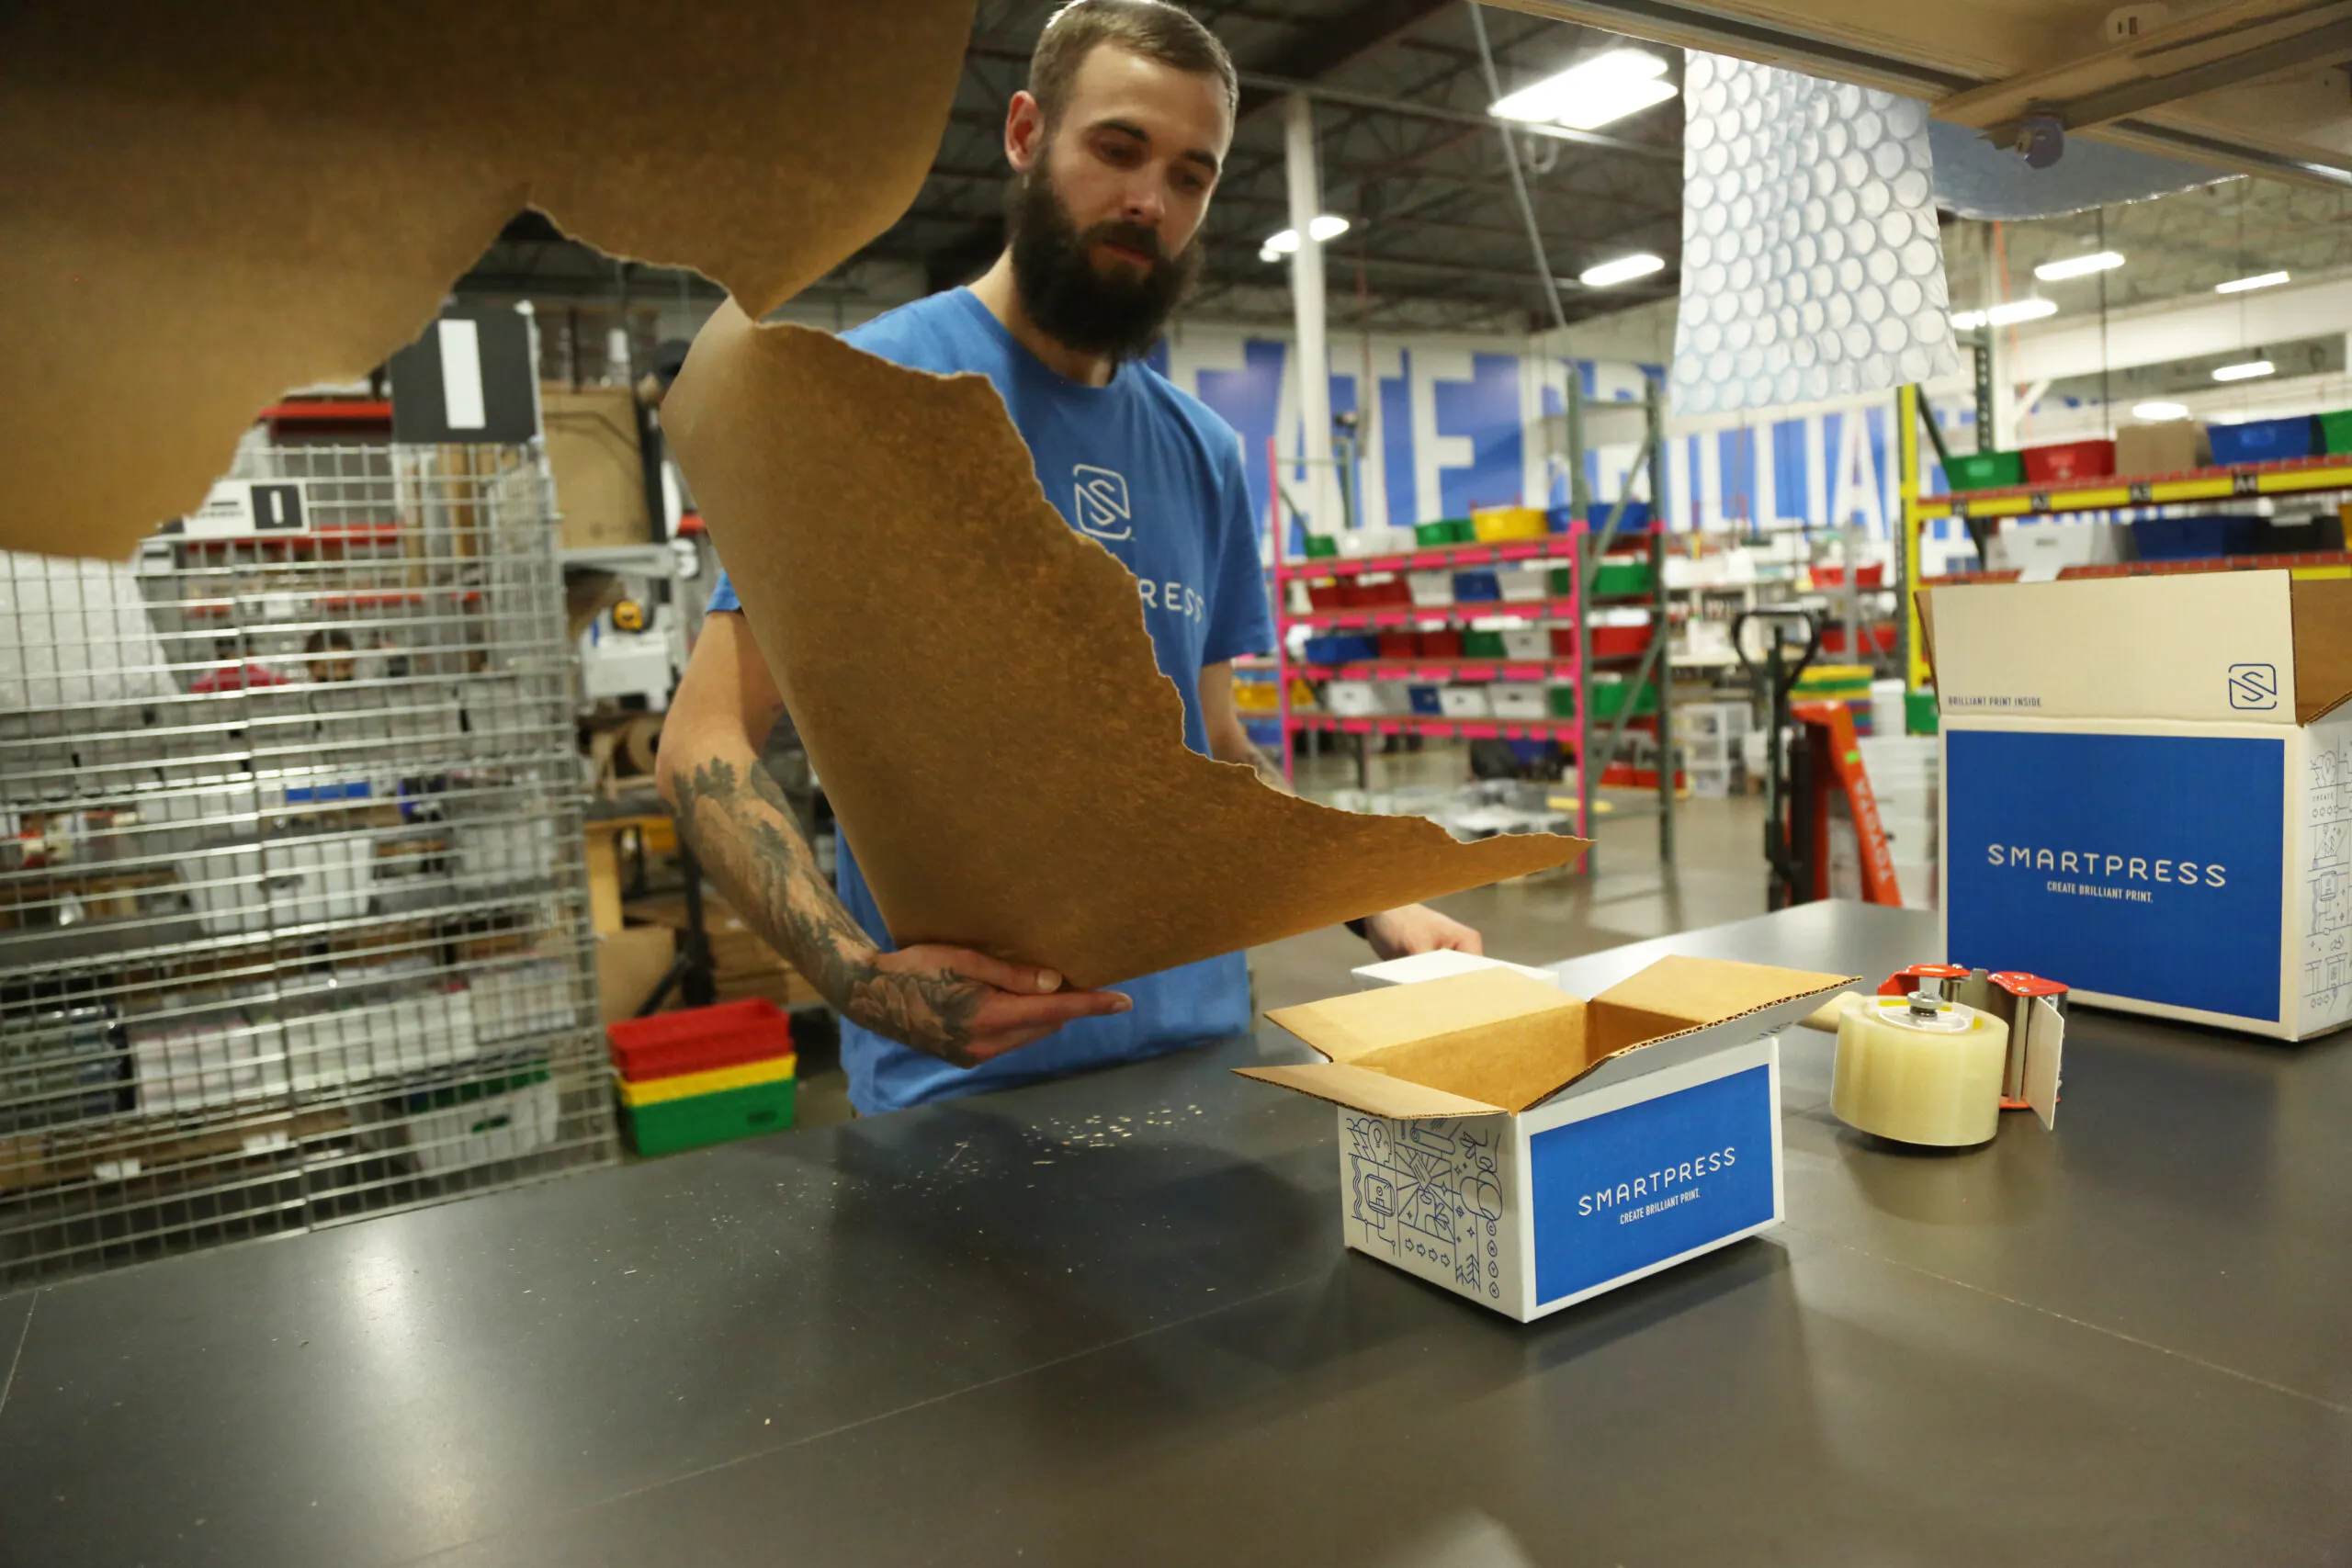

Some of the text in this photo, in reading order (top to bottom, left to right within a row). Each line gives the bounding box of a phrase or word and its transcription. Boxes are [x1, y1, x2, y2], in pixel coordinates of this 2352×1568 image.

[1138, 578, 1204, 624] RESS
[1949, 696, 1986, 706] BRILLIANT
[1989, 697, 2011, 706] PRINT
[1987, 843, 2227, 887] SMARTPRESS
[2047, 881, 2154, 903] CREATE BRILLIANT PRINT.
[1578, 1147, 1736, 1216] SMARTPRESS
[1620, 1187, 1701, 1224] CREATE BRILLIANT PRINT.
